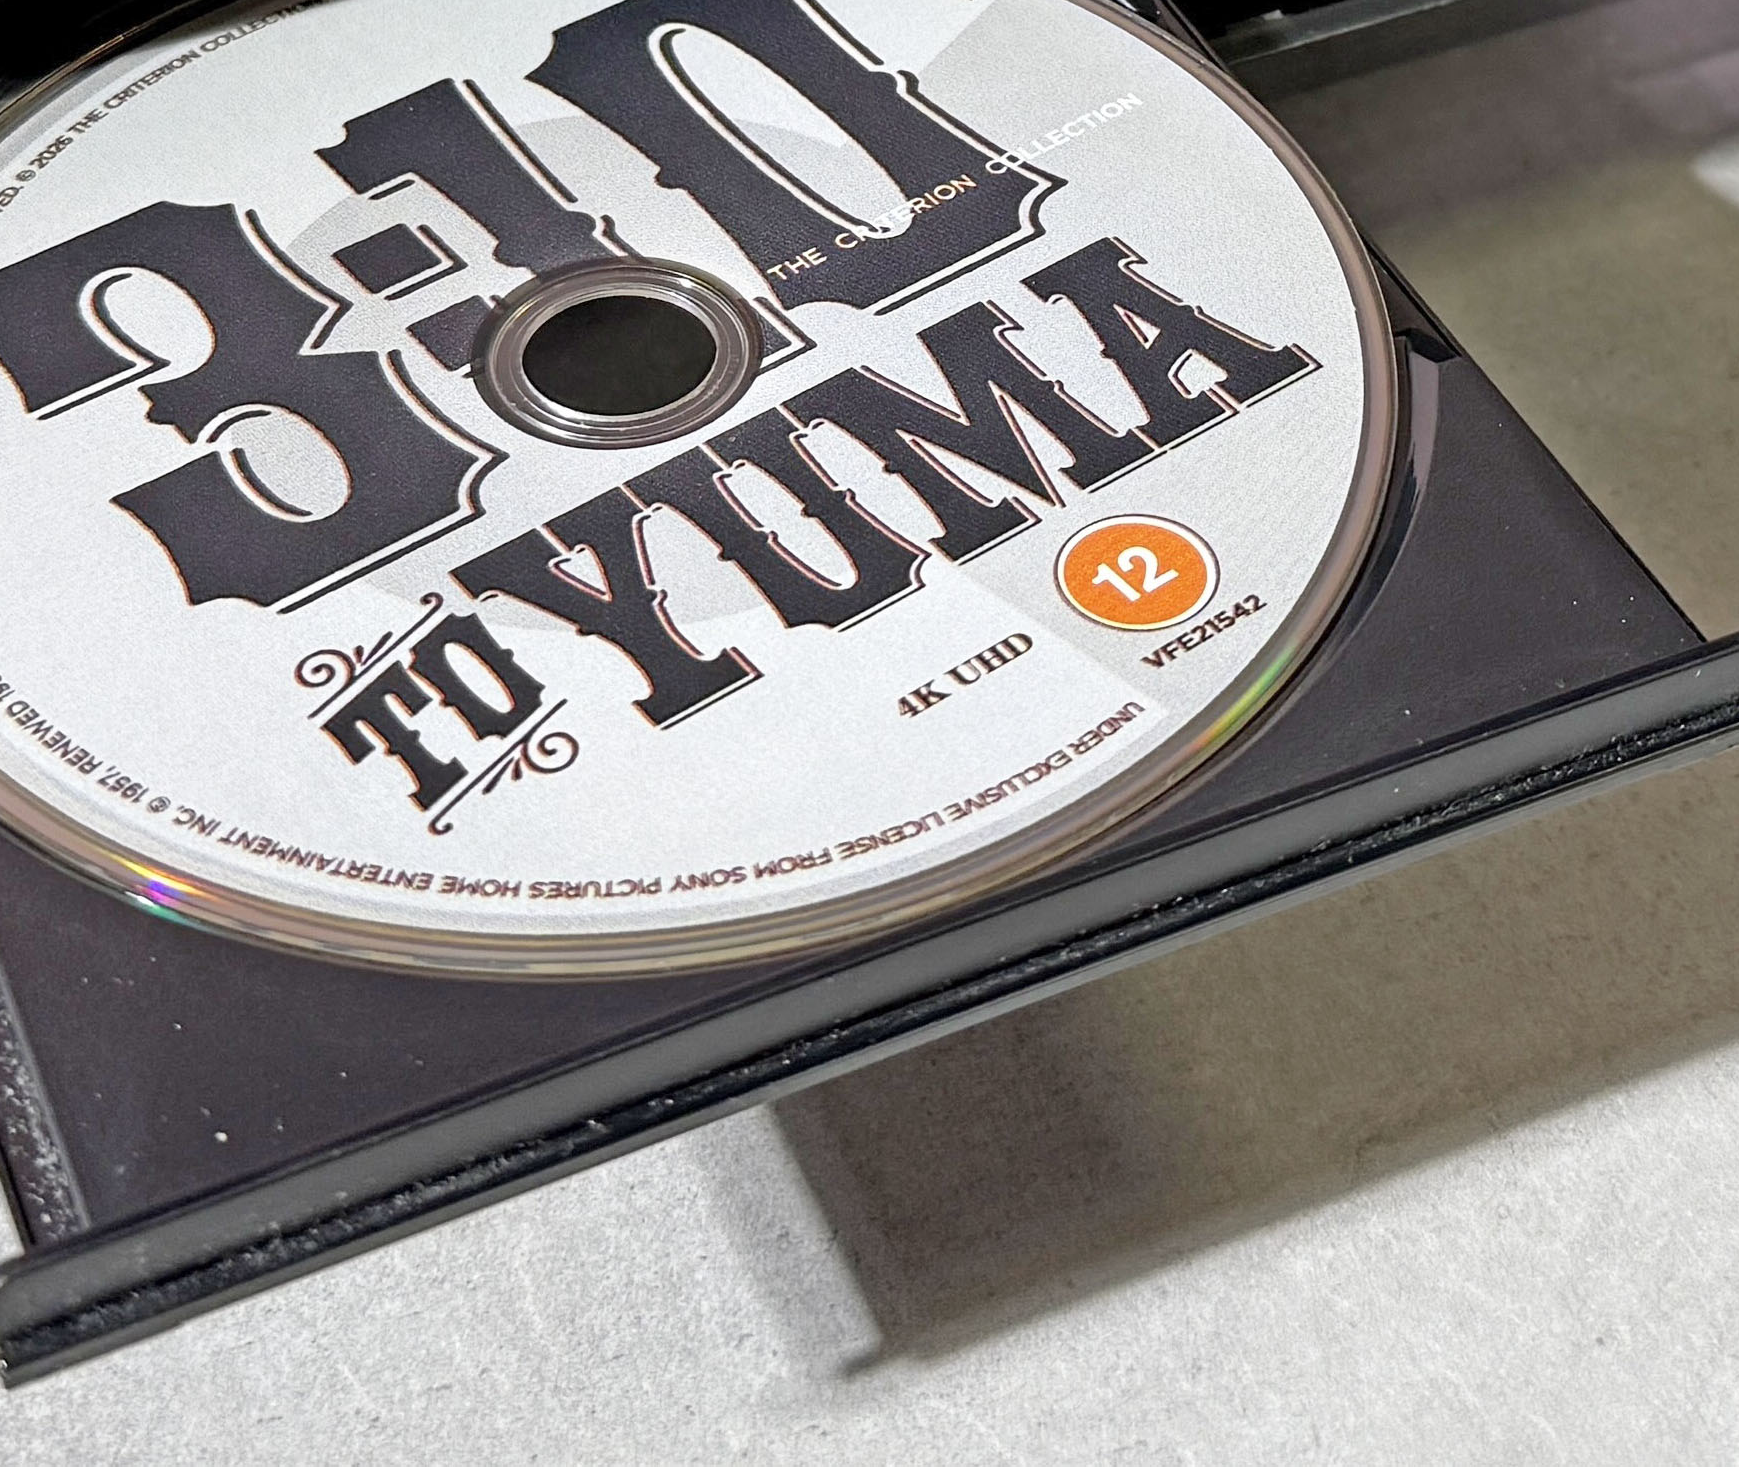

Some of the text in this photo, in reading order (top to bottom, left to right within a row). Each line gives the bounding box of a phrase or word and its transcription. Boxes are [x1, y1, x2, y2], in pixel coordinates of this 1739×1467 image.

[103, 49, 201, 110] CRITERION
[66, 108, 109, 134] THE
[766, 91, 1144, 283] THE CRITERION COLLECTION
[320, 236, 1323, 813] TO YUMA
[1091, 544, 1180, 602] 12
[1140, 593, 1268, 670] VFE21542
[896, 632, 1034, 718] 4K UHD
[5, 699, 104, 776] RENEWED
[1068, 701, 1145, 756] UNDER
[97, 763, 151, 805] 1957,
[944, 749, 1073, 822] EXCLUSIVE
[173, 804, 224, 837] INC.
[834, 810, 945, 860] LICENSE
[218, 828, 436, 892] ENTERTAINMENT
[438, 874, 522, 899] HOME
[670, 865, 748, 893] SONY
[753, 846, 833, 880] FROM
[528, 876, 663, 901] PICTURES
